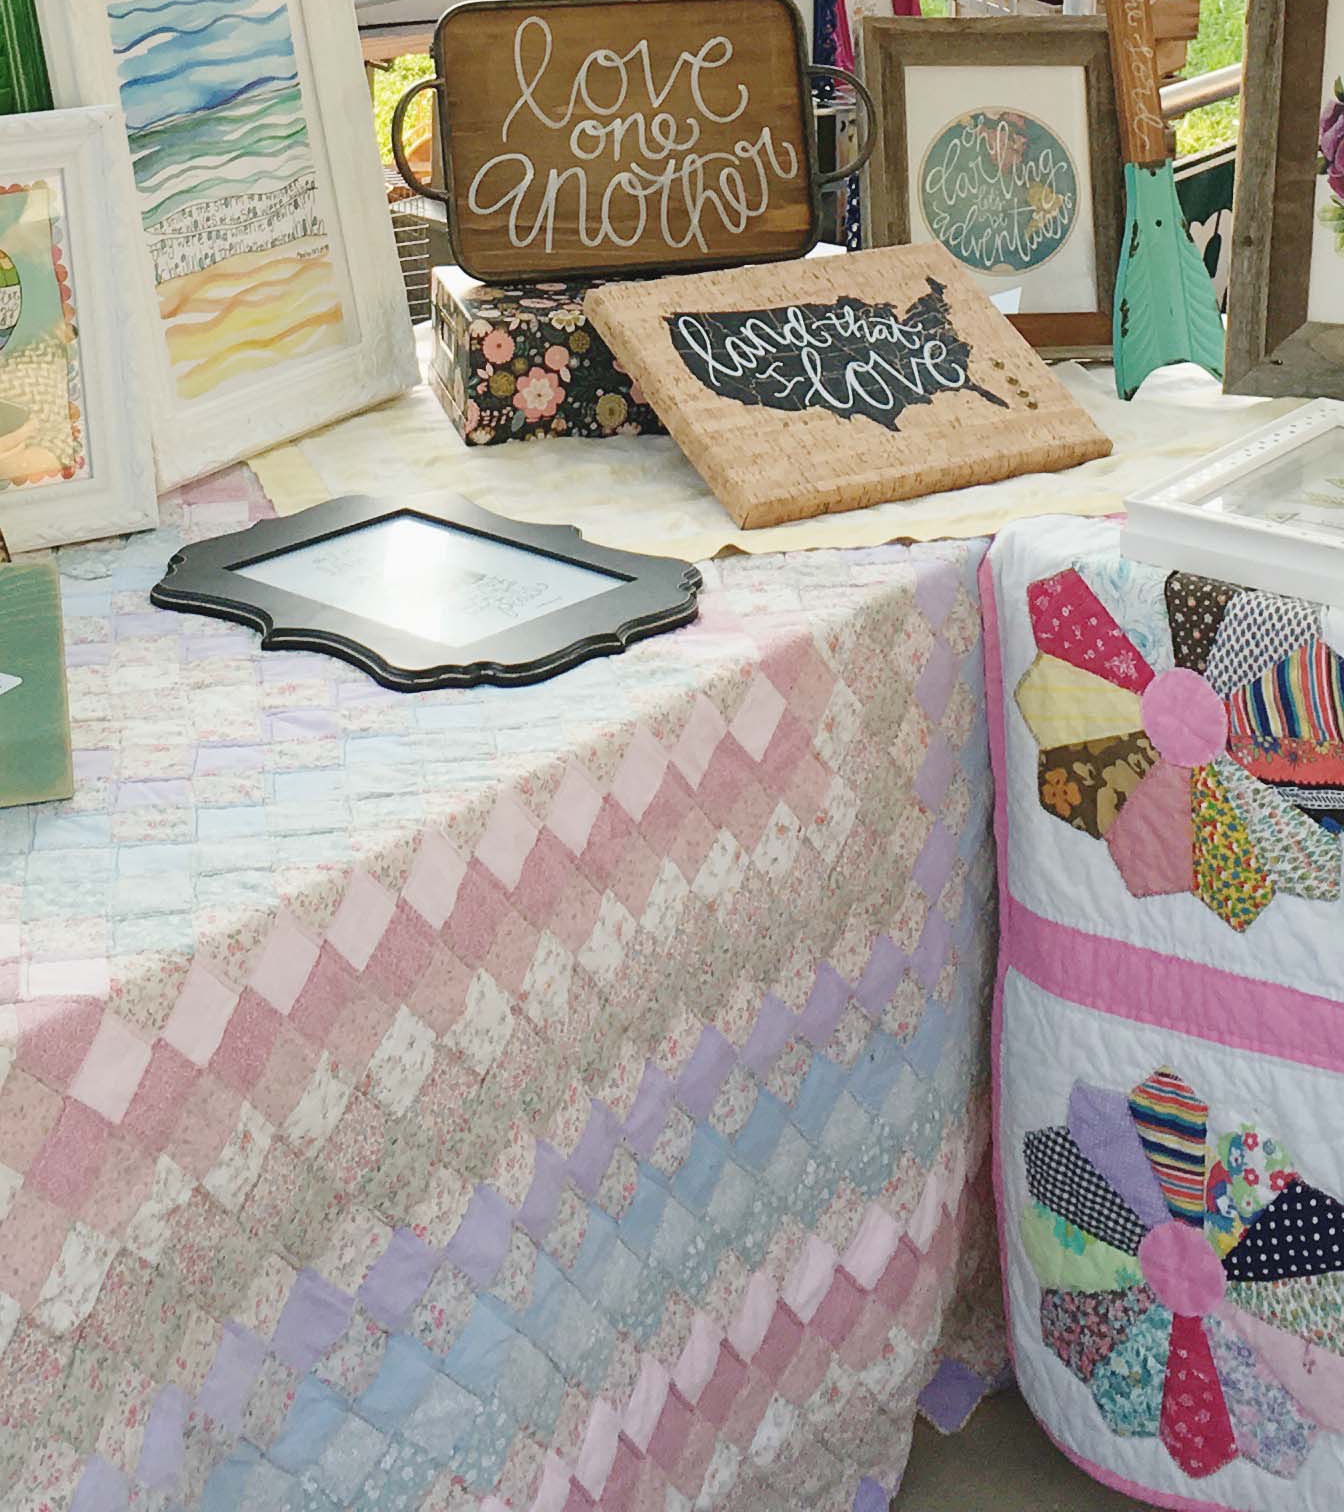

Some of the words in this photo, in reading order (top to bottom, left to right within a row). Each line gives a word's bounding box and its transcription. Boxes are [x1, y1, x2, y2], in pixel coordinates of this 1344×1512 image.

[501, 15, 749, 144] love
[569, 111, 700, 161] one
[925, 120, 1068, 210] darling
[961, 115, 995, 155] oh
[467, 126, 798, 254] another
[679, 306, 832, 387] land
[827, 305, 922, 350] that
[755, 361, 805, 398] I
[802, 339, 966, 410] love
